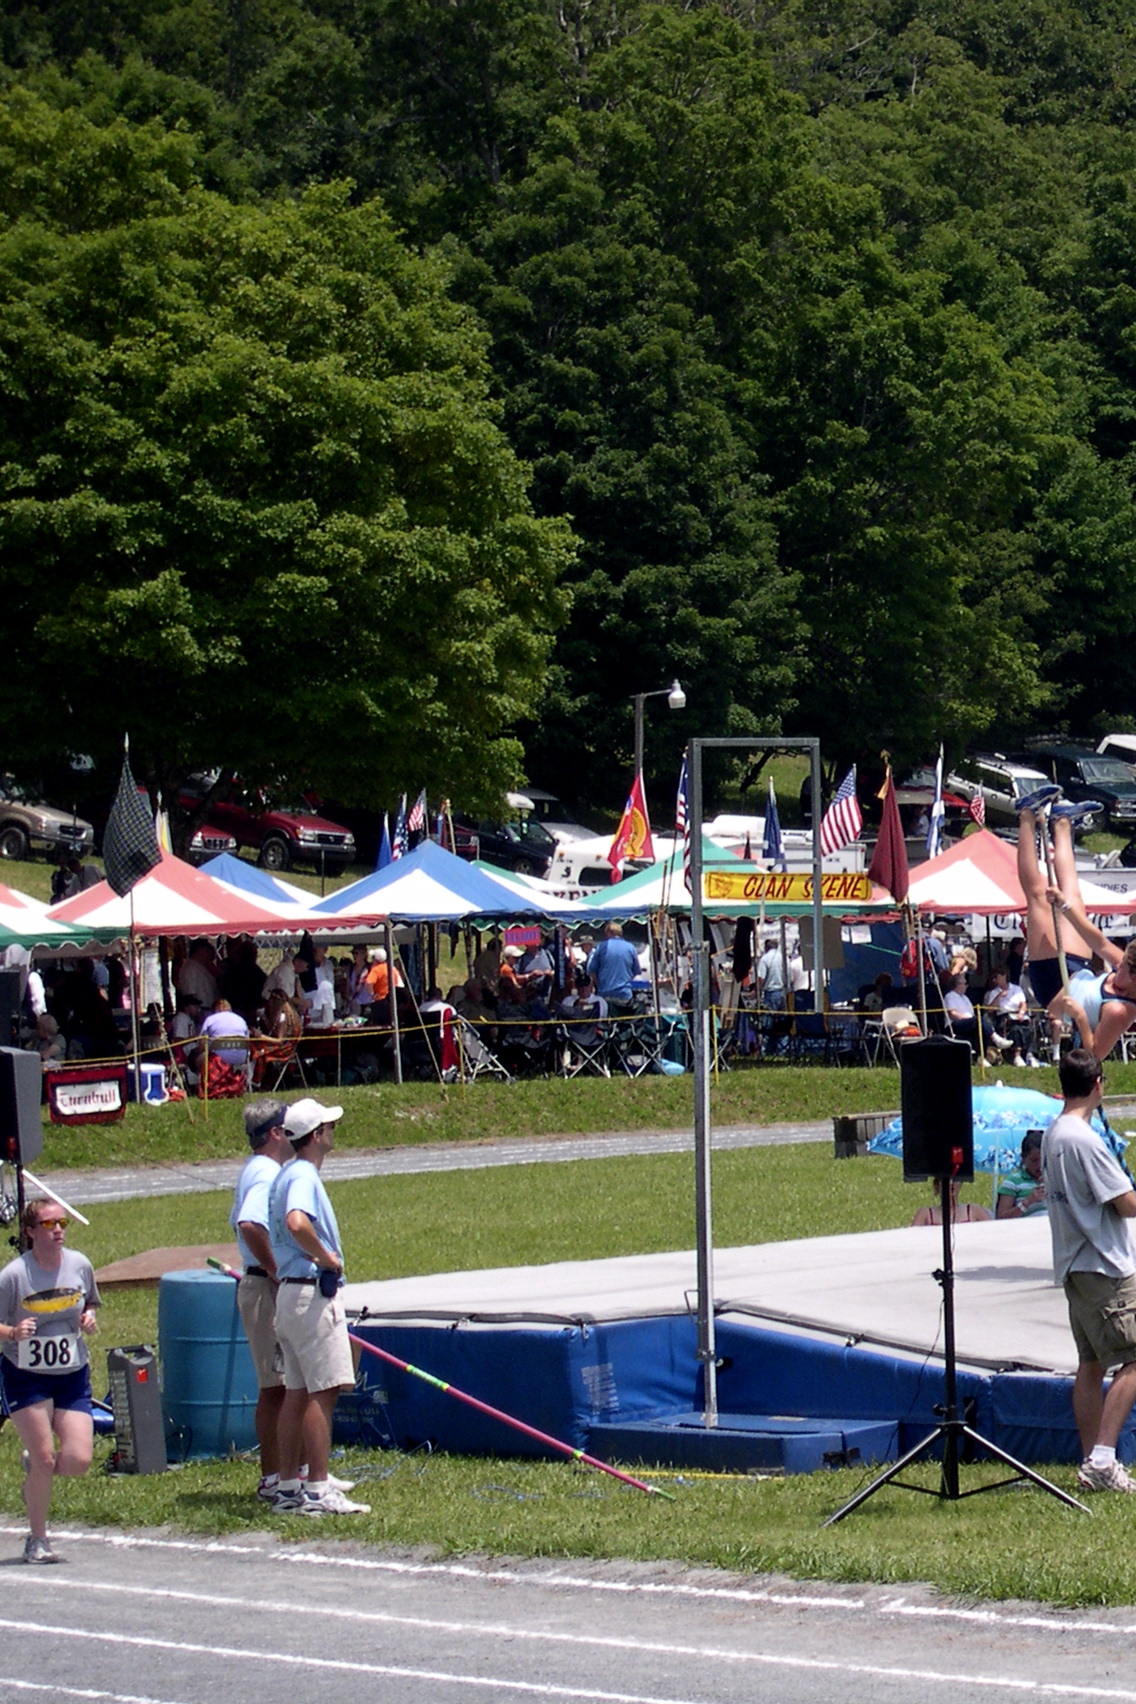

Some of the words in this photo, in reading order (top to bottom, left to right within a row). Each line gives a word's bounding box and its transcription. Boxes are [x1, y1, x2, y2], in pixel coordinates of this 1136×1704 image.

[743, 875, 794, 899] CLAN
[59, 1089, 116, 1108] Turnbull
[28, 1337, 71, 1368] 308
